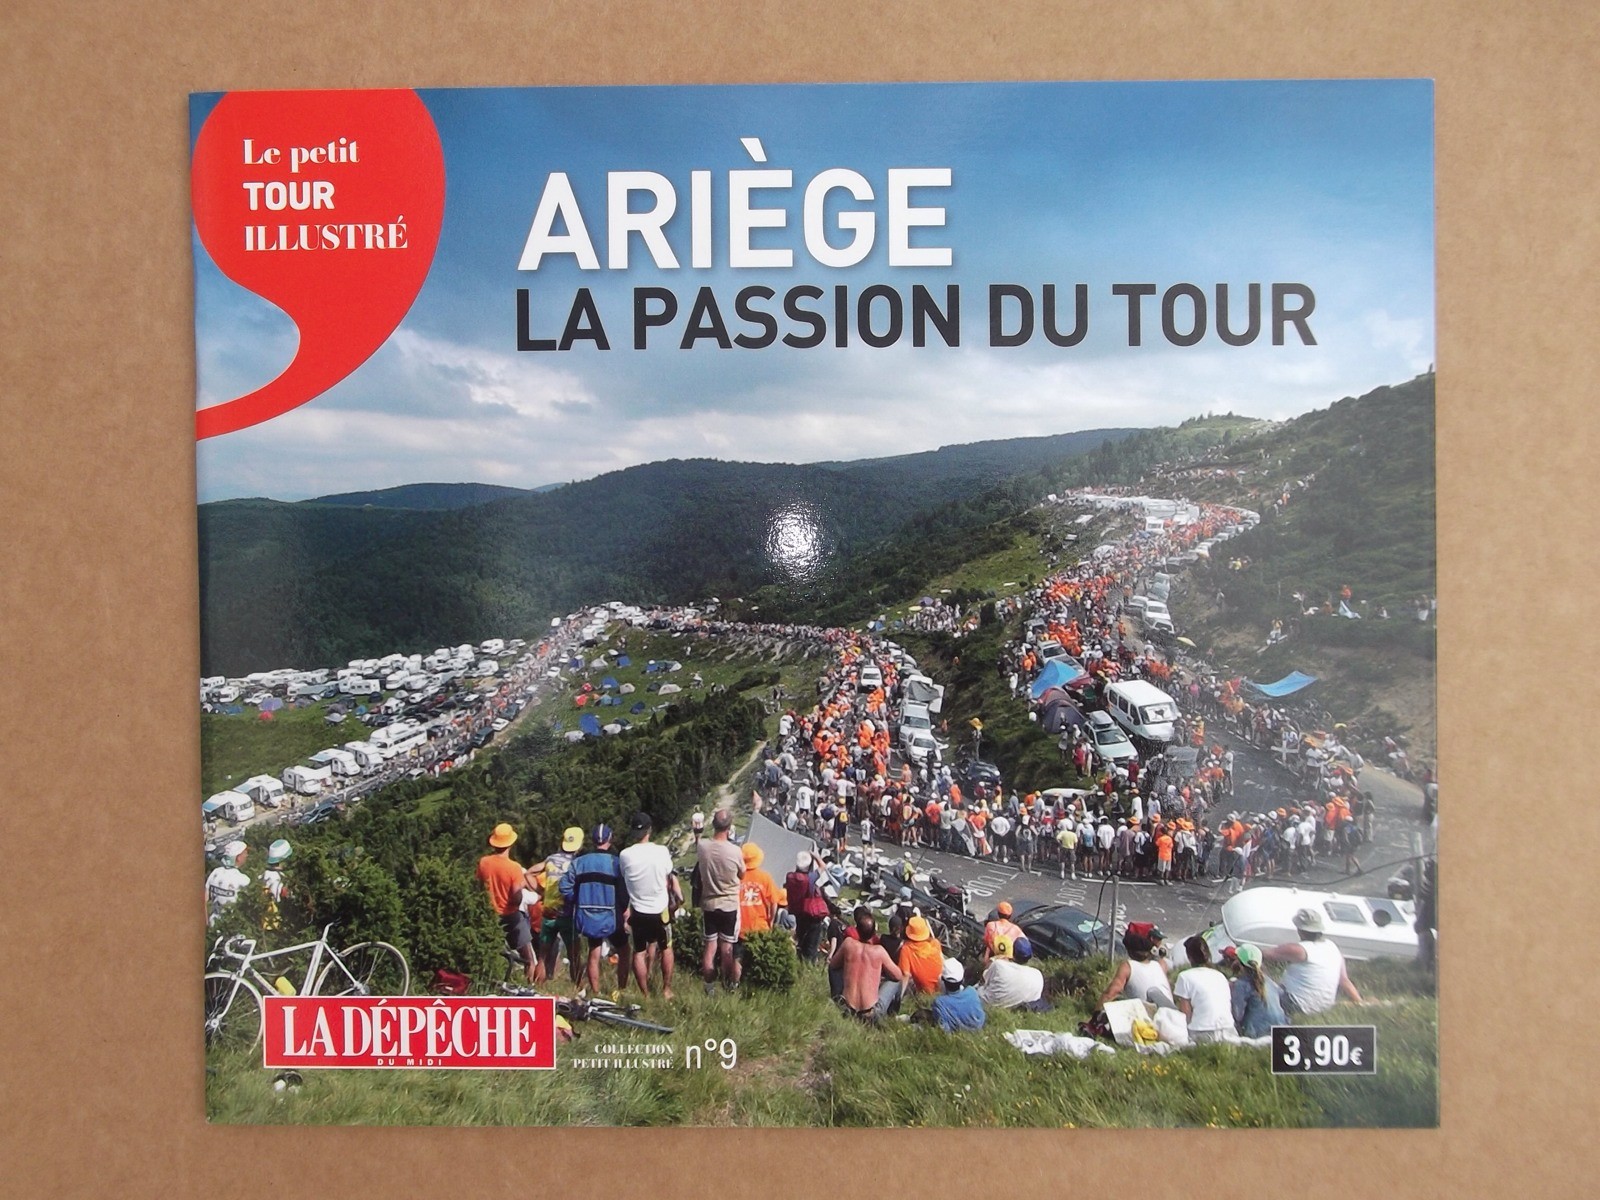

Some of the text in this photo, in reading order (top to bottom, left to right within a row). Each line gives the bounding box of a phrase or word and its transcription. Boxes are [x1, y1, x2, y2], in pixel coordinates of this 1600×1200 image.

[242, 137, 361, 173] Le petit
[242, 181, 336, 212] TOUR
[517, 137, 953, 272] ARIÈGE
[244, 214, 409, 252] ILLUSTRÉ
[516, 282, 1319, 352] LA PASSION DU TOUR
[281, 998, 537, 1058] LA DÉPÊCHE
[377, 1058, 442, 1067] DU MIDI
[571, 1056, 675, 1070] PETIT ILLUSTRÉ
[594, 1043, 675, 1055] COLLECTION
[685, 1038, 738, 1070] n°9
[1283, 1034, 1364, 1071] 3,90€
